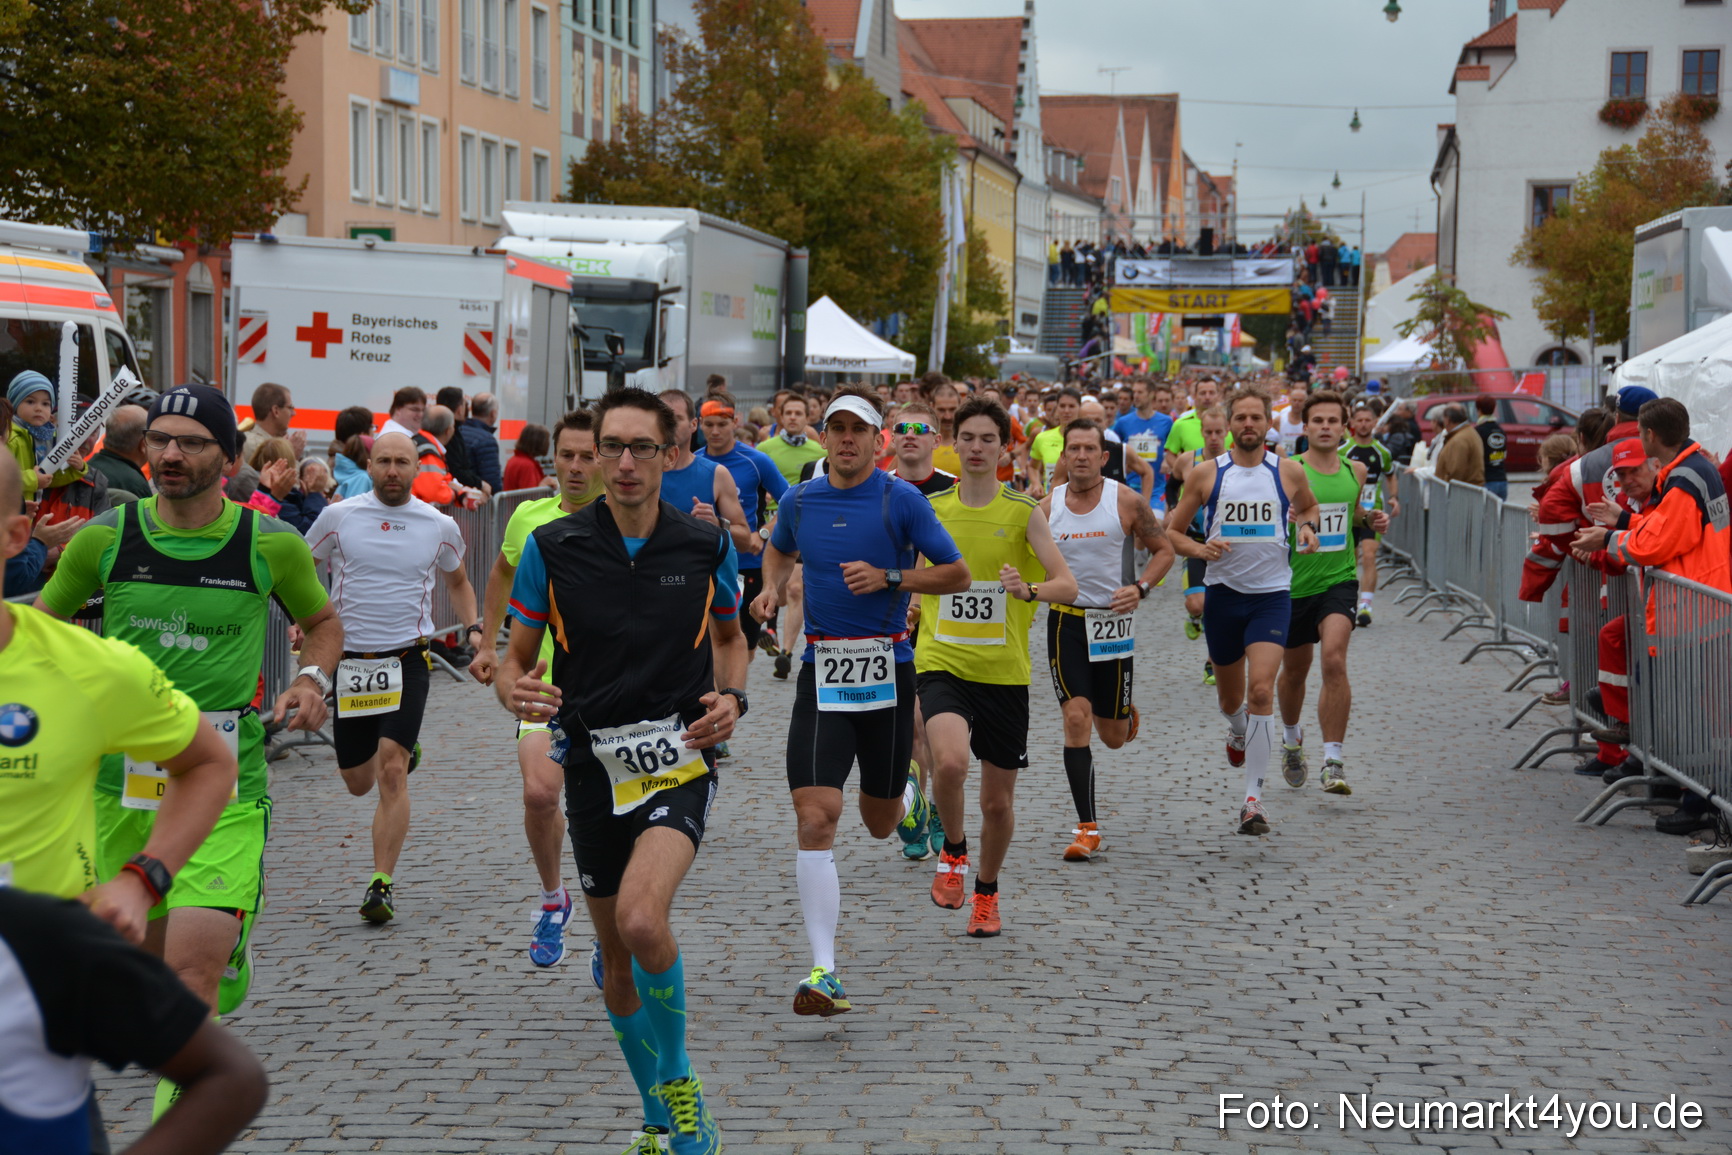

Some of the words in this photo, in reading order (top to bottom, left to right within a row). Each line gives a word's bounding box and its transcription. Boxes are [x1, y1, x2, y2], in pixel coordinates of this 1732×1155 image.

[1168, 294, 1231, 309] START
[352, 313, 439, 330] Bayerisches
[350, 331, 392, 346] Rotes
[349, 348, 392, 364] Kreuz
[811, 354, 868, 368] Laufsport
[46, 376, 130, 466] bmw-laufsport.de
[1224, 502, 1272, 522] 2016
[392, 523, 406, 531] dpd
[1239, 527, 1257, 535] Tom
[200, 576, 247, 588] FrankenBlitz
[660, 575, 686, 583] GORE
[951, 595, 993, 620] 533
[130, 615, 178, 633] SoWiso
[186, 622, 213, 635] Run
[217, 625, 226, 635] &
[226, 623, 242, 636] Fit
[1092, 618, 1133, 640] 2207
[843, 645, 880, 655] Neumarkt
[1100, 642, 1130, 654] Wolfgang
[340, 664, 362, 673] PARTL
[824, 656, 888, 684] 2273
[349, 671, 389, 693] 379
[350, 697, 392, 709] Alexander
[837, 690, 877, 702] Thomas
[629, 724, 672, 740] Neumarkt
[0, 753, 38, 770] artl
[615, 737, 679, 774] 363
[0, 771, 36, 779] umarkt
